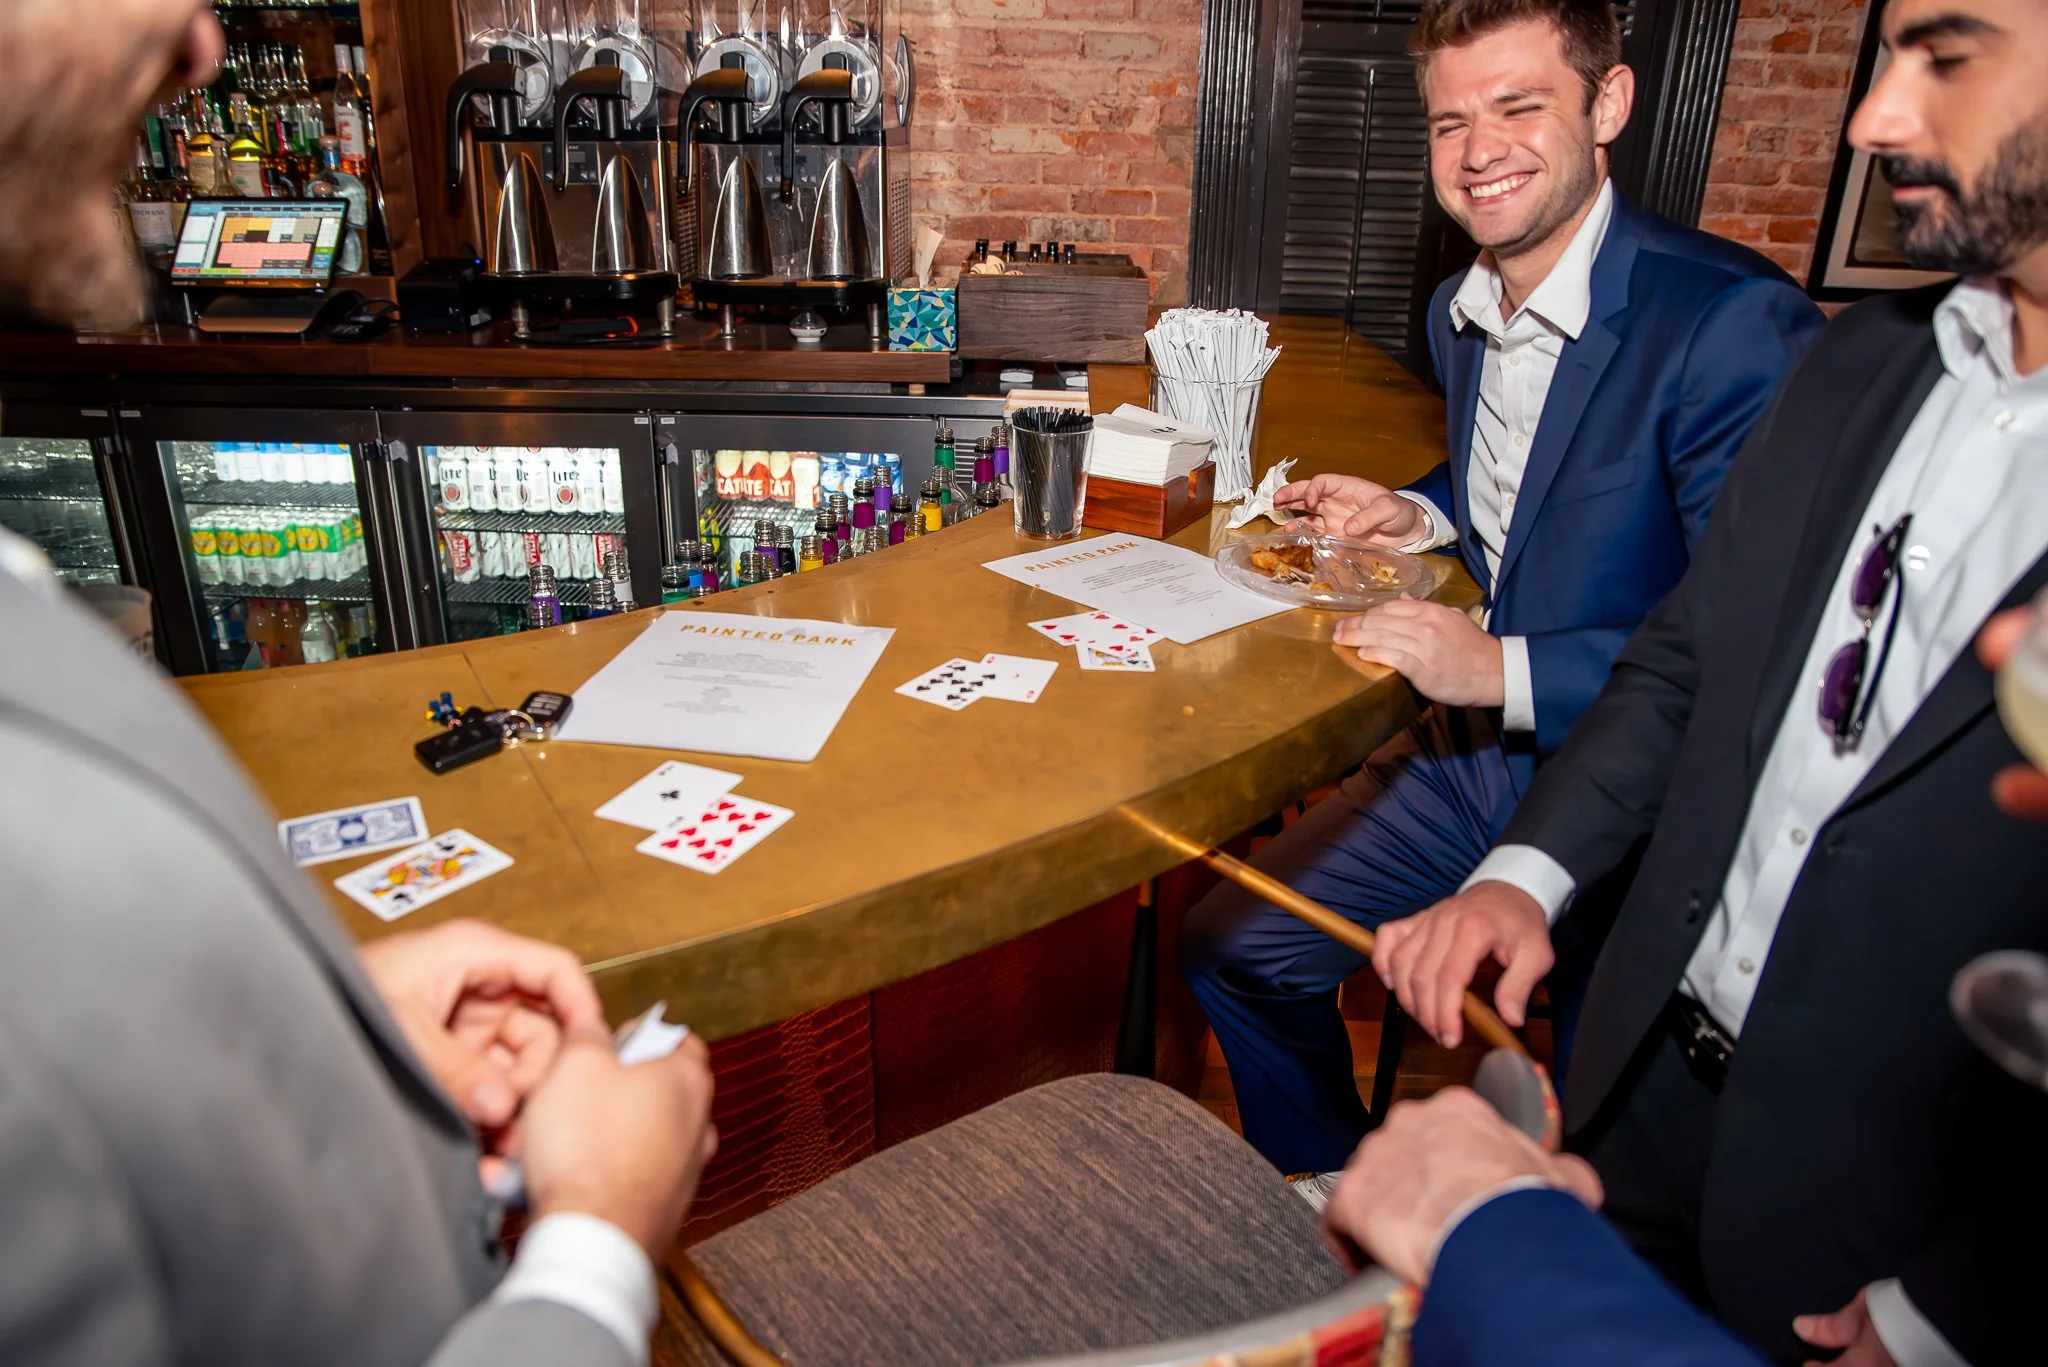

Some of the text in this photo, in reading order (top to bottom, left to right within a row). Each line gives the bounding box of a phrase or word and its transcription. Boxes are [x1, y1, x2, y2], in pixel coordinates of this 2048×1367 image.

[1024, 541, 1141, 572] PAINTED PARK
[680, 623, 783, 641] PAINTED
[792, 633, 857, 647] PARK
